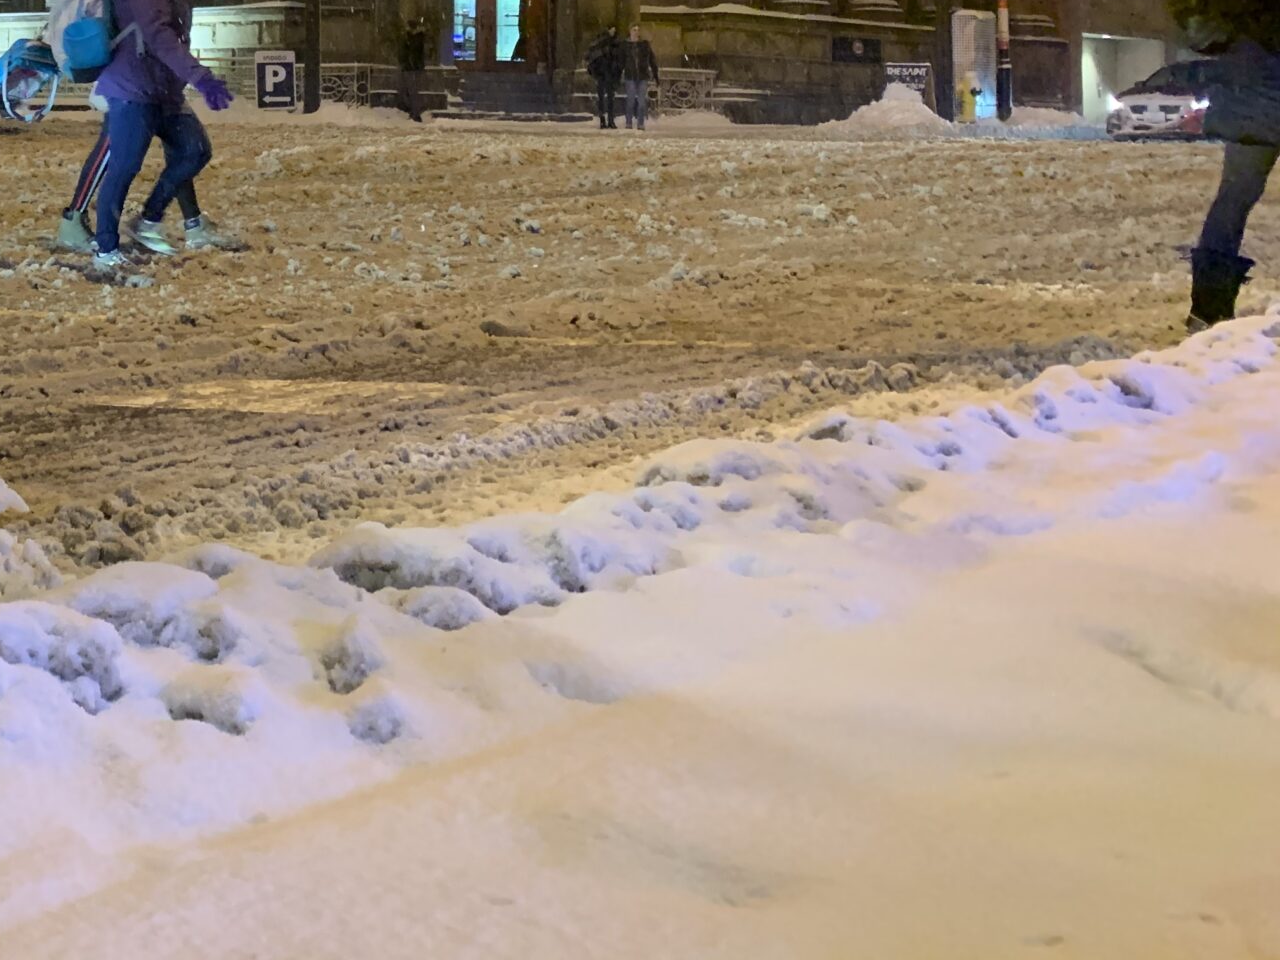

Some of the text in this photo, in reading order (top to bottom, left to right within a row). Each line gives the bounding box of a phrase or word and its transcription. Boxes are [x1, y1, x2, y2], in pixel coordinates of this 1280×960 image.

[265, 64, 287, 93] P
[886, 67, 928, 77] THE SAINT
